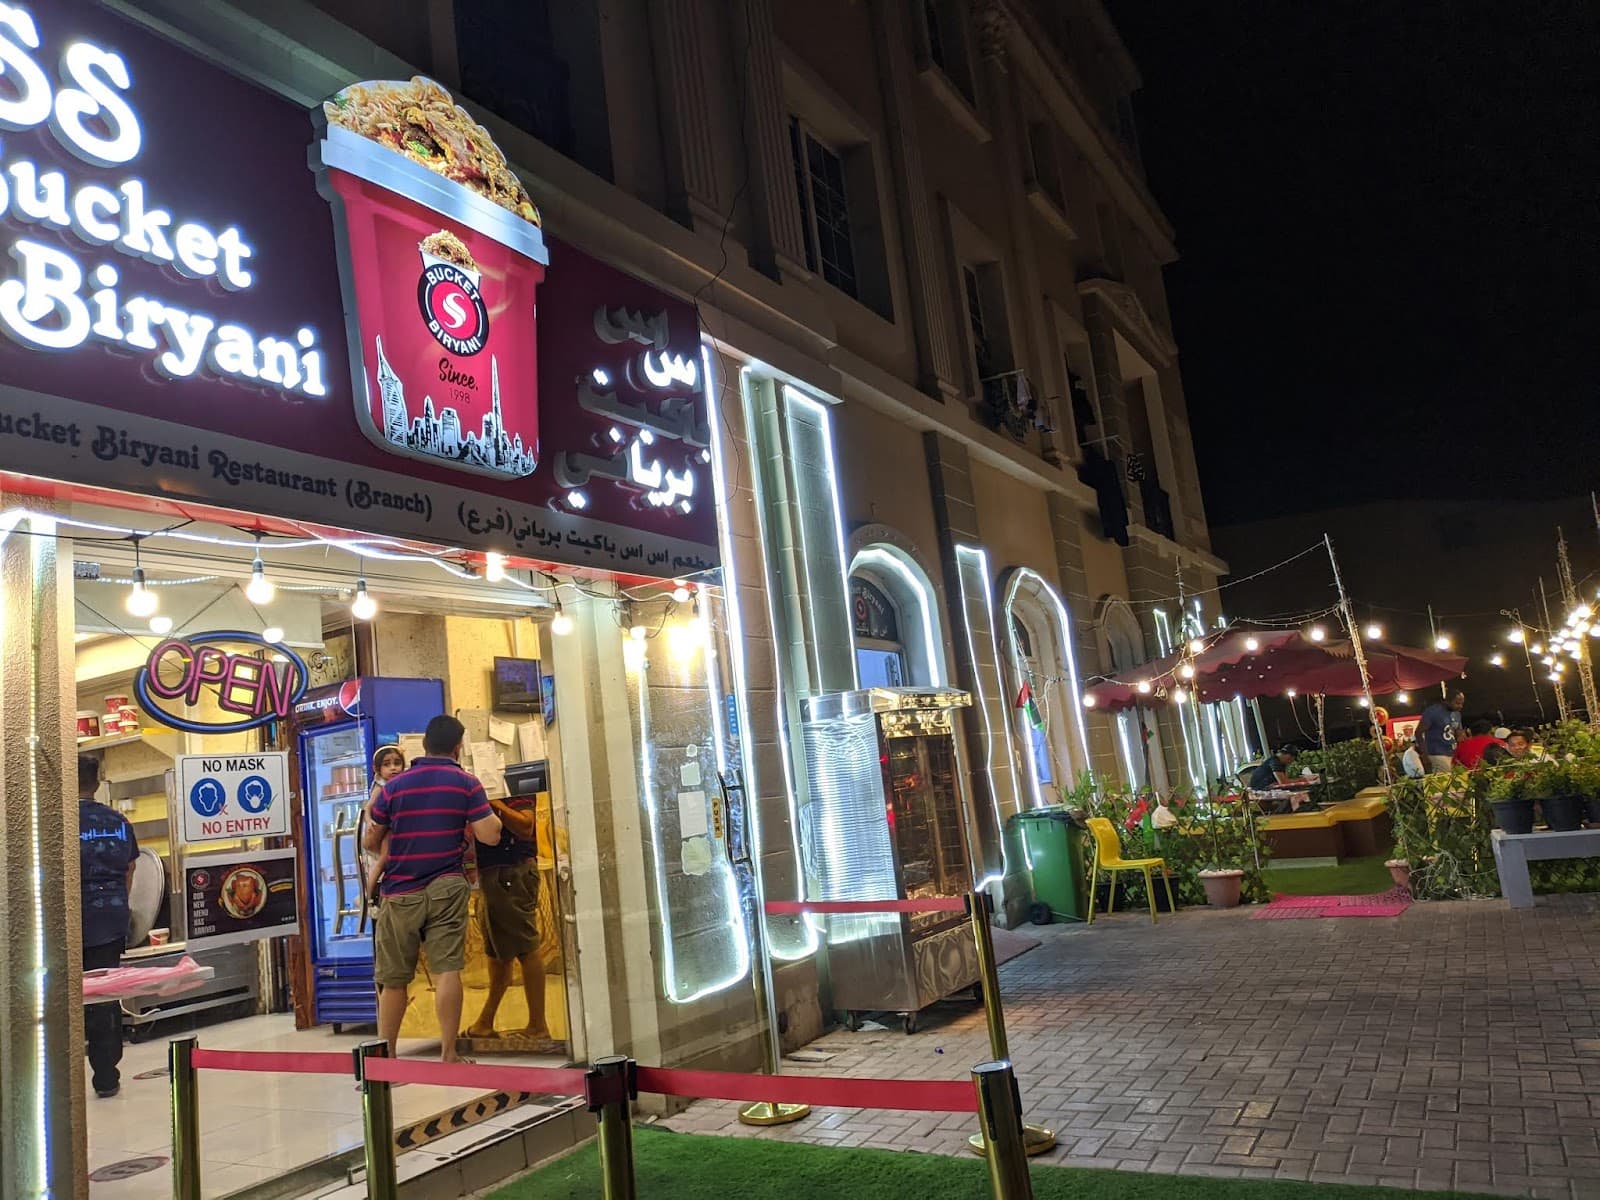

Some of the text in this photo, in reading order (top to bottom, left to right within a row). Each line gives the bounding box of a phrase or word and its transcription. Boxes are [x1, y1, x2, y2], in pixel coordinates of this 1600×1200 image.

[0, 158, 253, 289] ucket
[426, 268, 480, 301] BUCKET
[0, 240, 326, 397] Biryani
[428, 318, 482, 354] BIRYANI
[438, 357, 479, 391] Since.
[450, 387, 471, 404] 1998
[0, 412, 432, 521] ucket Biryani Restaurant (Branch)
[514, 516, 561, 549] برياني
[567, 529, 616, 558] باكيت
[148, 640, 296, 718] OPEN
[202, 758, 266, 773] NO MASK
[202, 817, 271, 836] NO ENTRY
